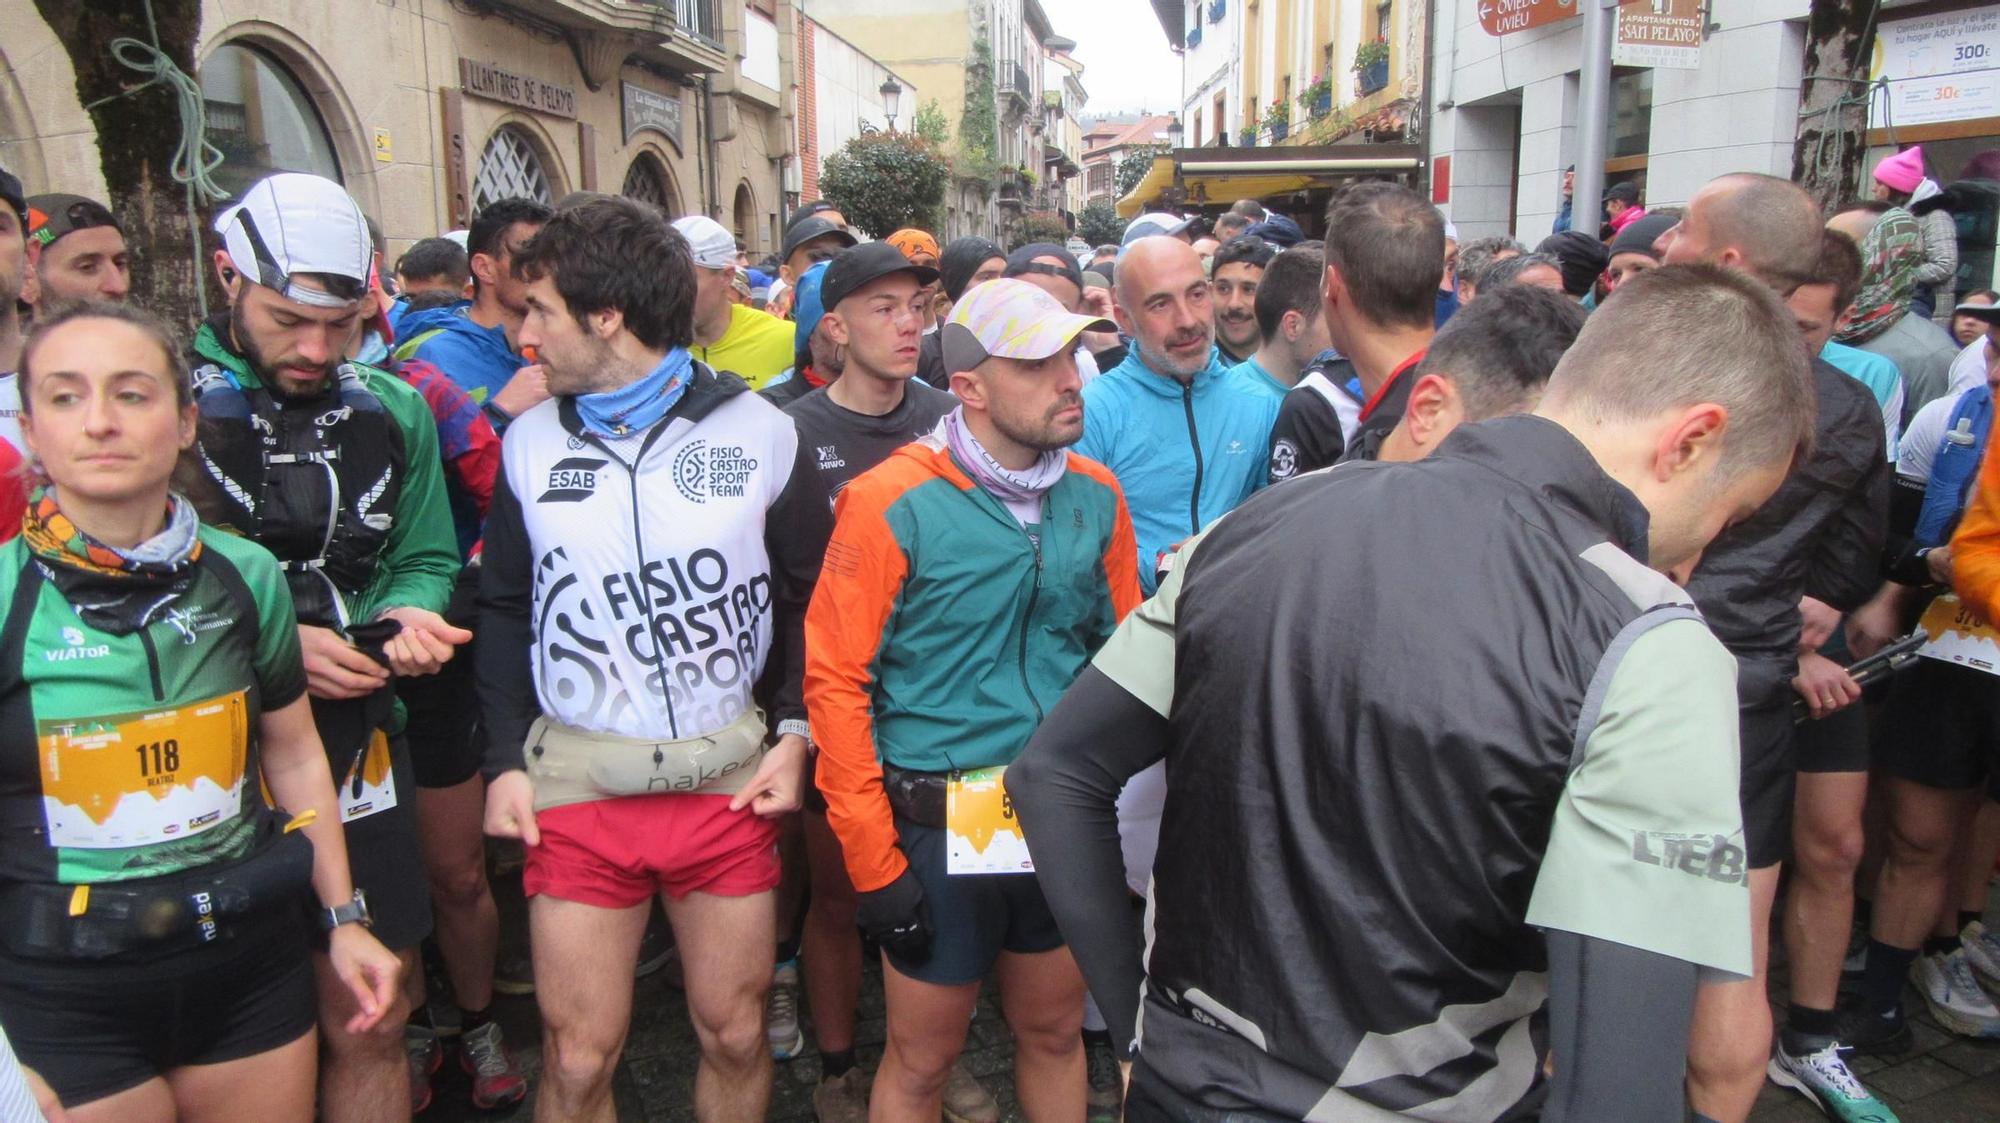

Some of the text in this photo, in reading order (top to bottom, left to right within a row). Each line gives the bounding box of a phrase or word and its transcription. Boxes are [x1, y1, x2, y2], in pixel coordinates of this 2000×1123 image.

[1625, 15, 1696, 26] APARTAMENTOS
[1896, 22, 1934, 34] Contrata
[1936, 18, 1945, 28] la
[1970, 13, 1979, 22] el
[1624, 25, 1695, 43] SAN PELAYO
[1896, 36, 1905, 44] tu
[1906, 32, 1932, 43] hogar
[1934, 28, 1955, 39] AQUÍ
[1965, 22, 1997, 34] llévate
[1954, 43, 1991, 61] 300€
[470, 62, 573, 113] LLANTARES DE PELAYO
[1934, 86, 1960, 101] 30€
[710, 446, 743, 459] FISIO
[709, 458, 758, 471] CASTRO
[548, 471, 596, 489] ESAB
[709, 472, 751, 485] SPORT
[709, 485, 744, 498] TEAM
[602, 547, 729, 621] FISIO
[624, 572, 773, 667] CASTRO
[46, 645, 111, 661] VIATOR
[644, 614, 760, 707] SPORT
[136, 738, 180, 777] 118
[191, 892, 217, 942] naked
